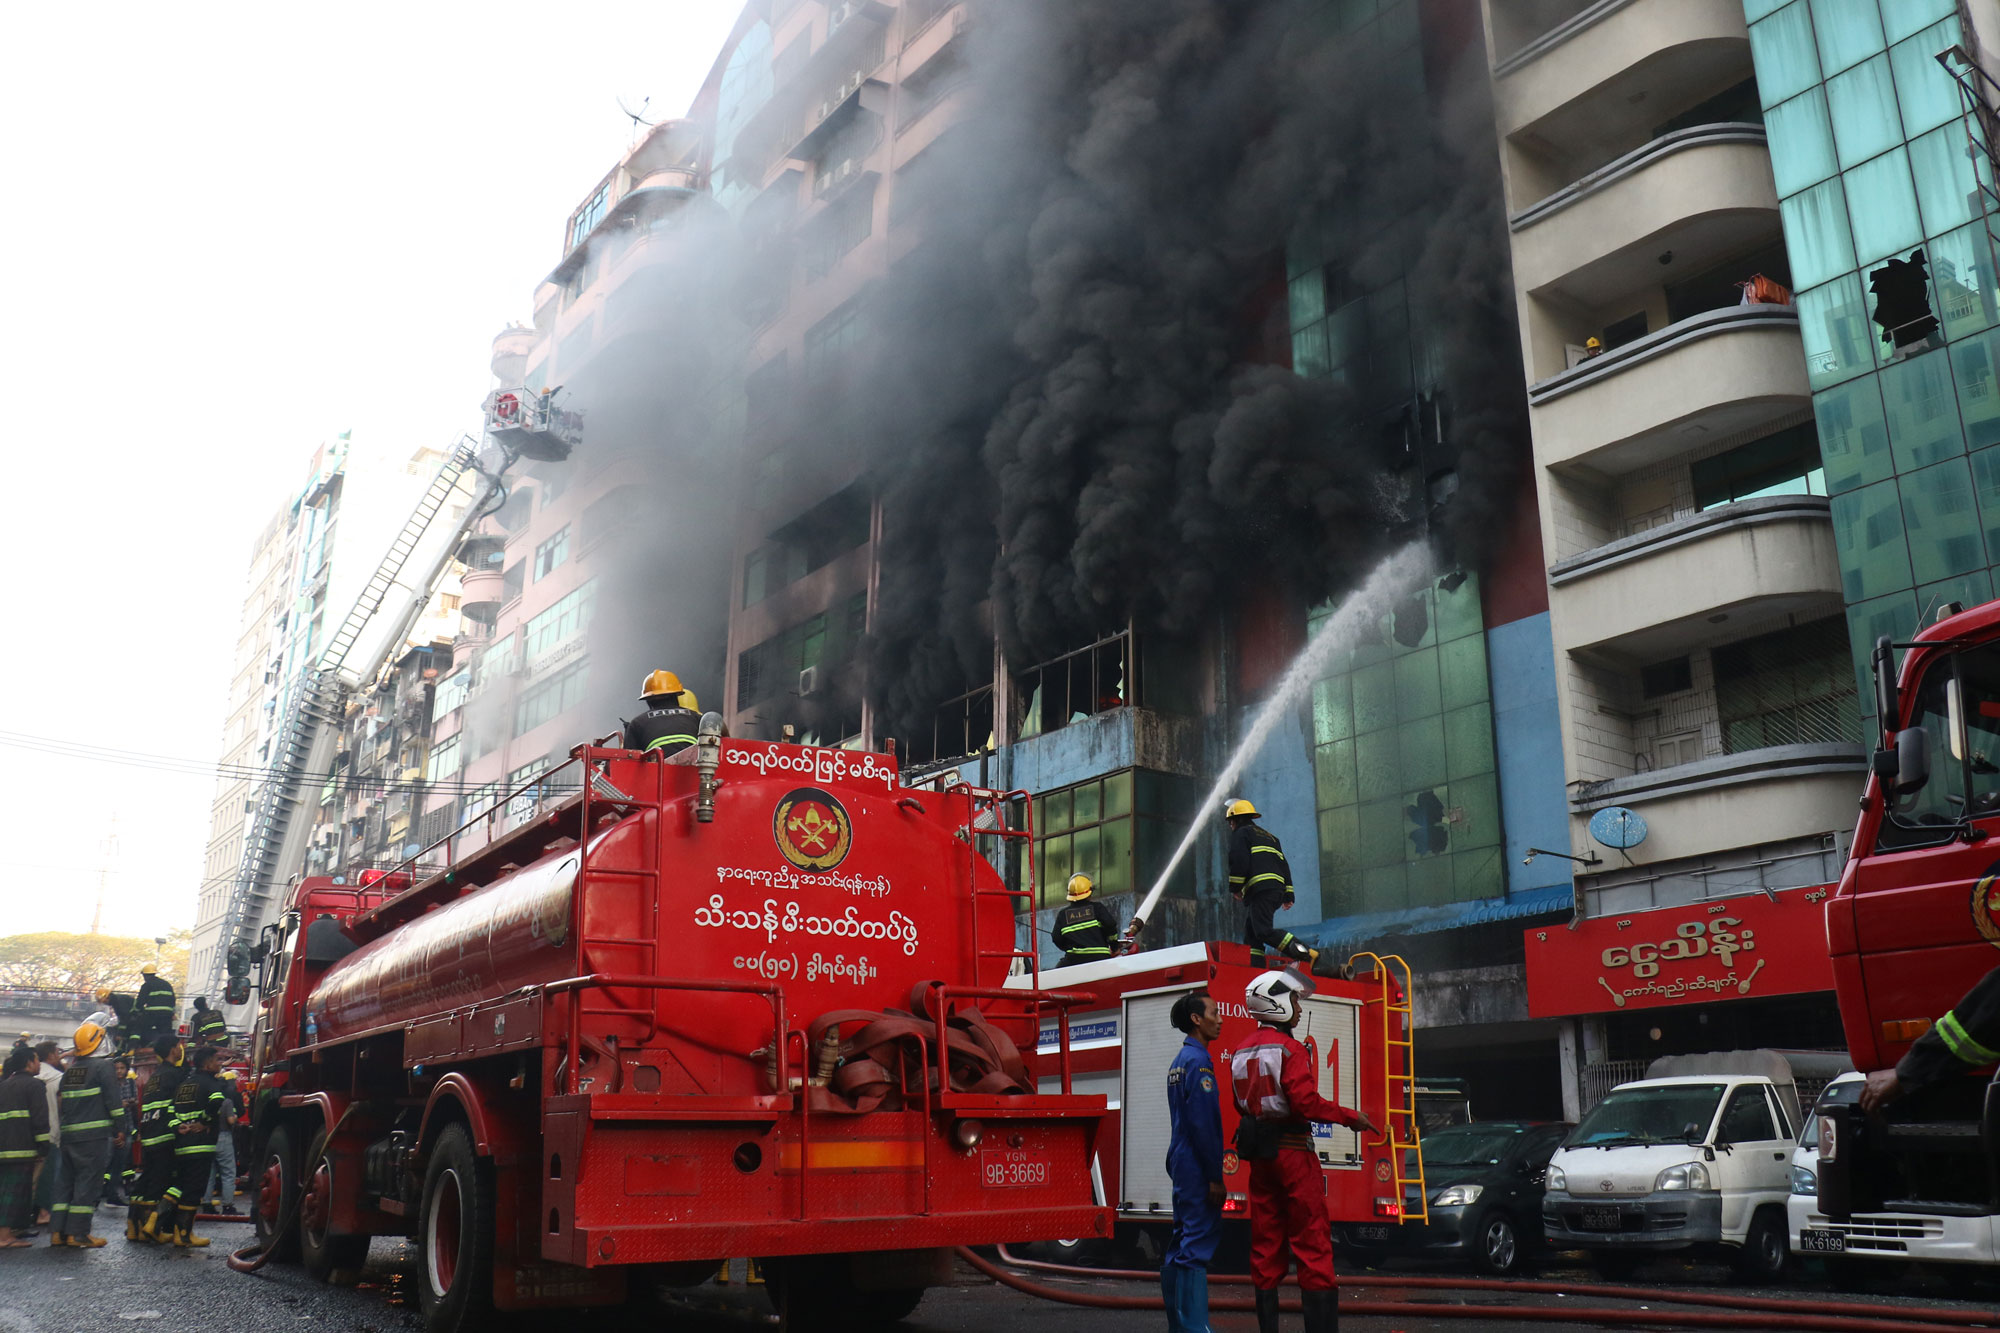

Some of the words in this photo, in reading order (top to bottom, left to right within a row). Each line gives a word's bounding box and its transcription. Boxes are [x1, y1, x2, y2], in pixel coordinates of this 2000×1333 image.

[1006, 1152, 1027, 1161] YGN
[986, 1163, 1045, 1184] 9B-3669
[1814, 1230, 1831, 1238] YGN
[1803, 1236, 1843, 1251] 1K-6199
